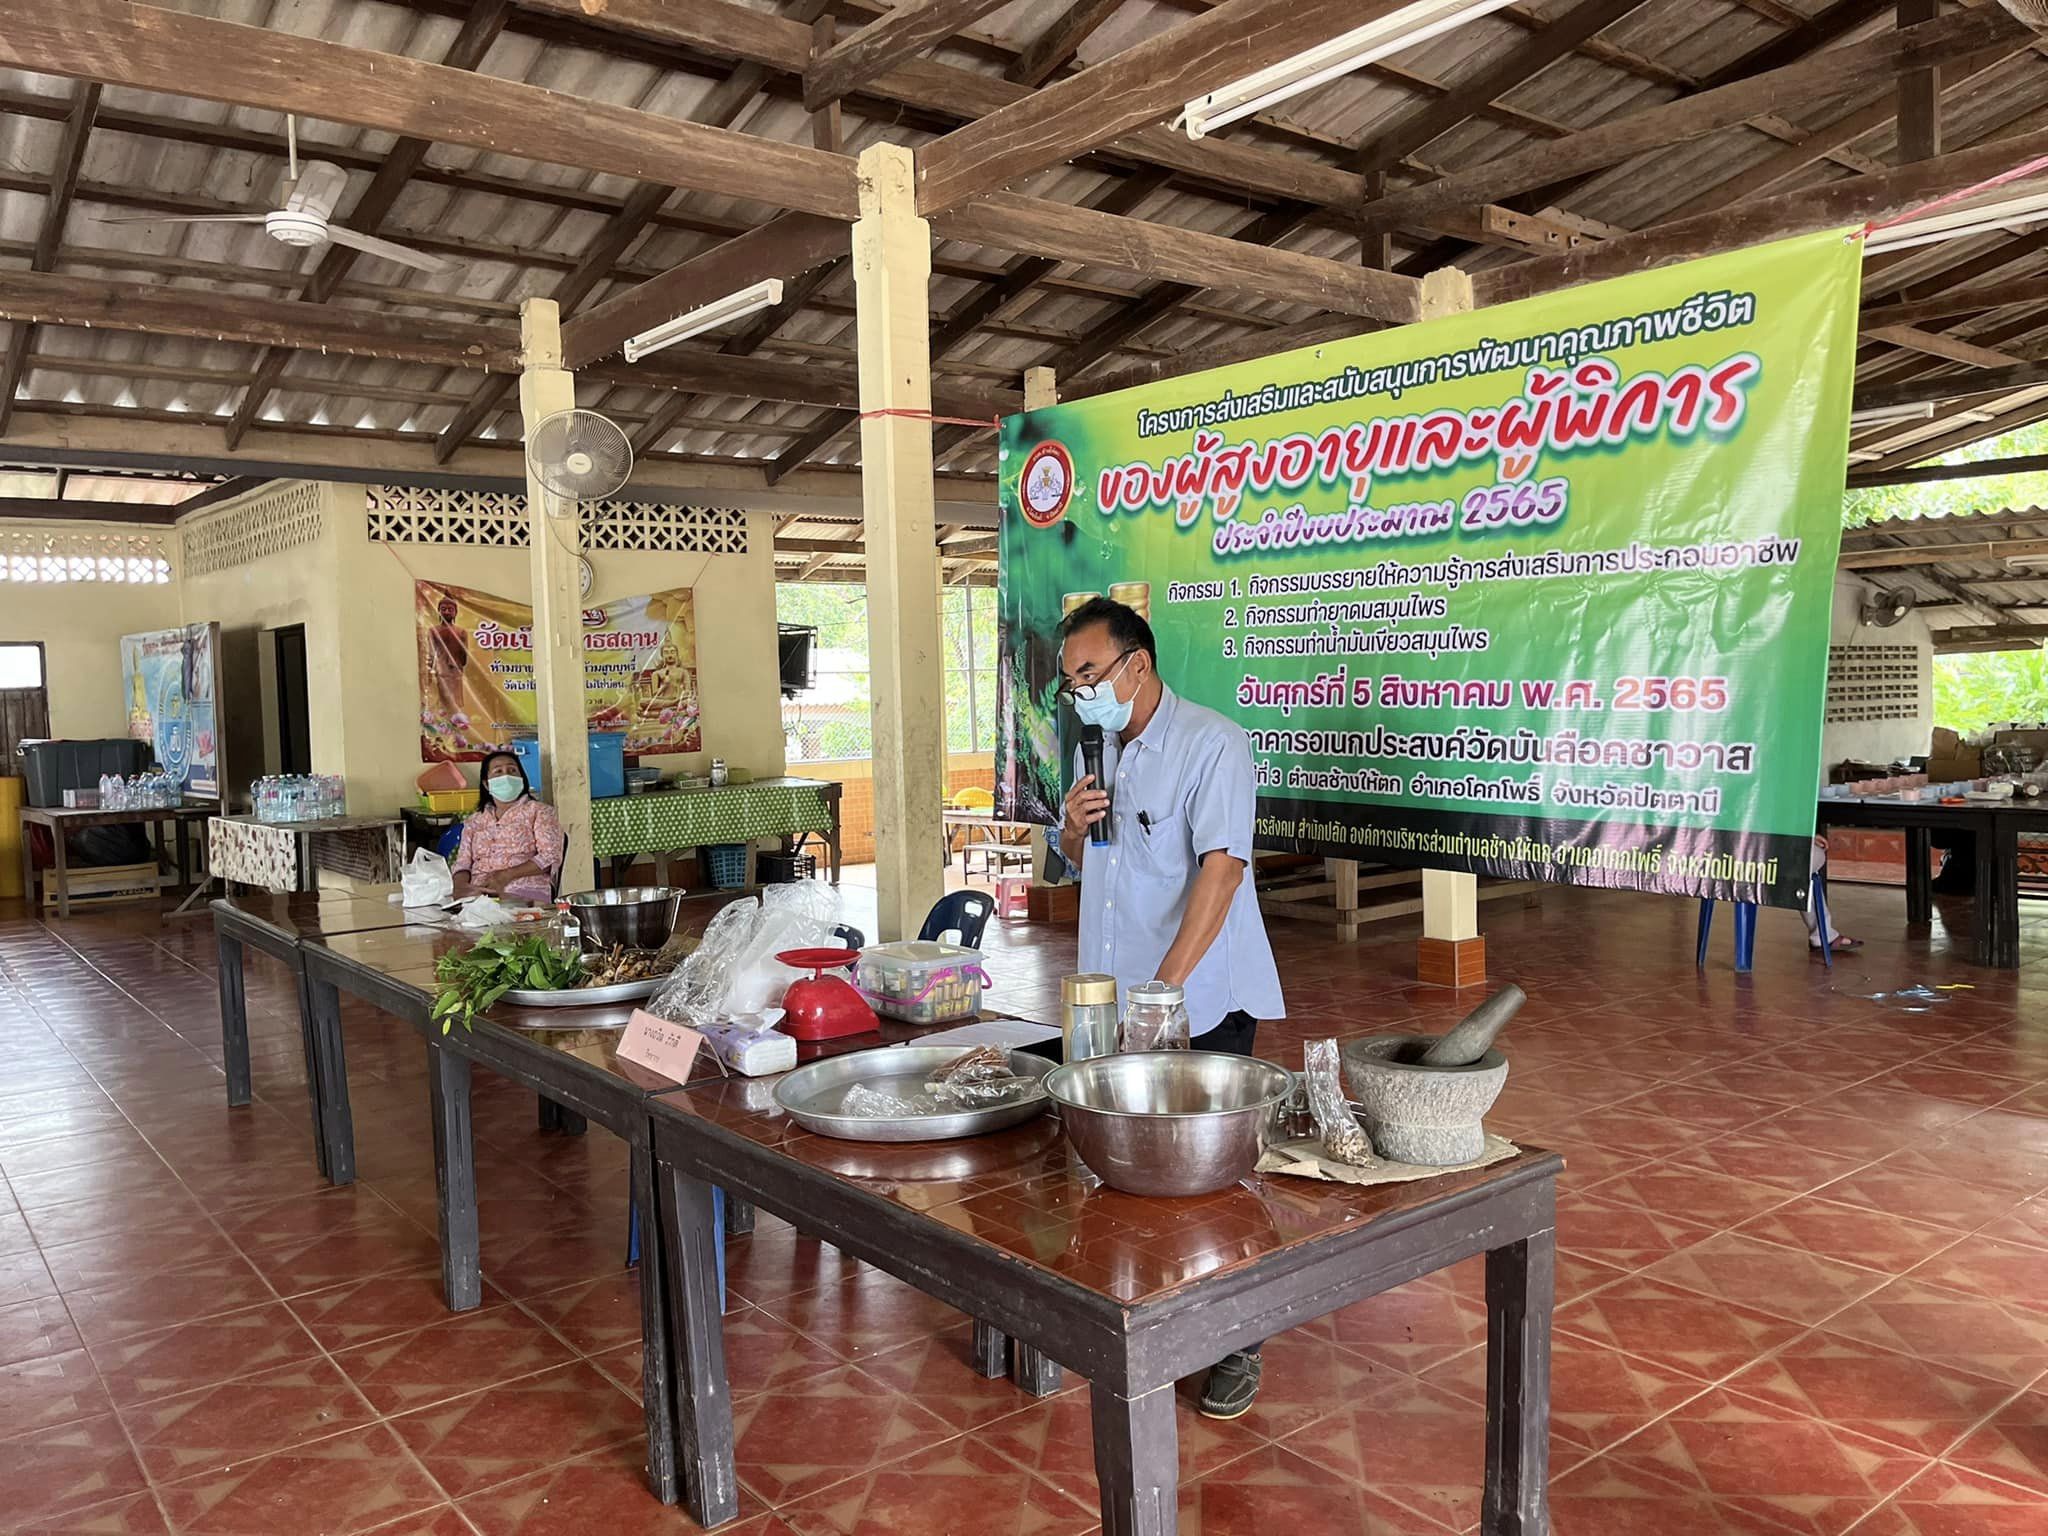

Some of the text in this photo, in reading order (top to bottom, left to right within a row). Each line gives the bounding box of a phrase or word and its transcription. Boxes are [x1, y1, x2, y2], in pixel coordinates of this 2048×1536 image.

[1138, 291, 1754, 437] โครงการส่งเสริมและสนับสนุนการพัฒนาคุณภาพชีวิต
[1100, 359, 1754, 521] ของผู้สูงอายุและผู้พิการ
[1215, 483, 1564, 550] ประจำปีงบประมาณ 2565
[1168, 539, 1799, 600] กิจกรรม 1. กิจกรรมบรรยายให้ความรู้การส่งเสริมการประกอบอาชีพ
[1225, 594, 1446, 626] 2. กิจกรรมทำยาดมสมุนไพร
[1224, 626, 1488, 658] 3. กิจกรรมทำน้ำมันเขียวสมุนไพร
[1238, 666, 1727, 715] วันศุกร์ที่ 5 สิงหาคม พ.ศ. 2565
[1246, 726, 1752, 771] าคารอเนกประสงค์วัดบันลือคชาวาส
[1271, 768, 1281, 785] 3
[1288, 768, 1401, 792] ตำบลช้างให้ตก
[1411, 772, 1540, 801] อำเภอโคกโพธิ์
[1554, 785, 1719, 813] จังหวัดปัตตานี
[1298, 818, 1347, 843] สำนักปลัด
[1557, 841, 1661, 873] อำเภอโคกโพธิ์
[1668, 856, 1778, 885] จังหวัดปัตตานี
